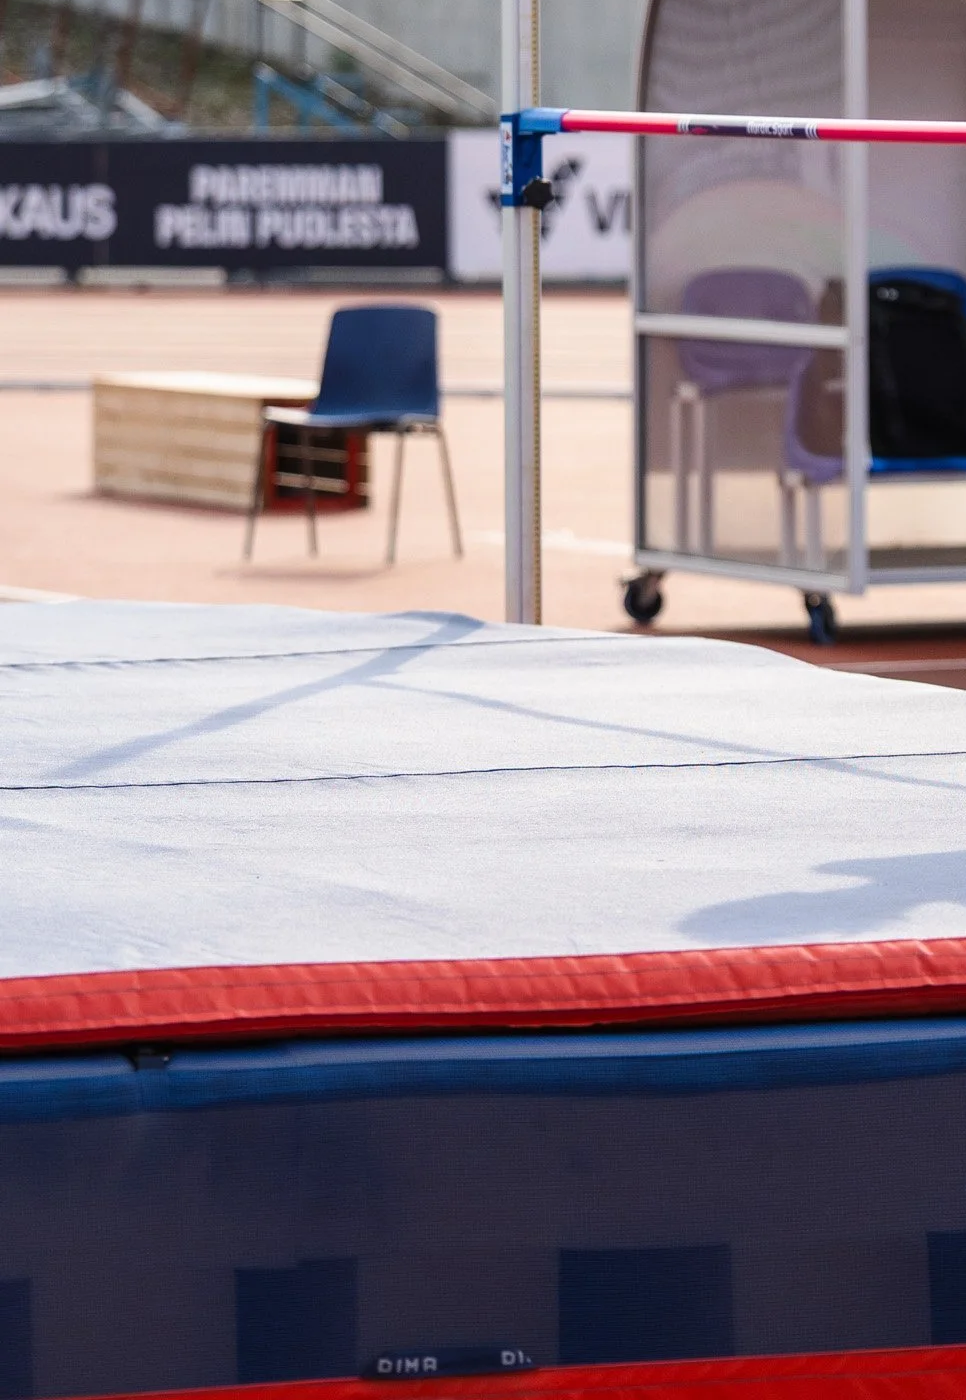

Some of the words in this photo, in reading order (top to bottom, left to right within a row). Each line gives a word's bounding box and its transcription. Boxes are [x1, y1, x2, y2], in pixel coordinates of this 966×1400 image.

[154, 204, 250, 249] PELIN
[255, 204, 419, 249] PUOLESTA
[377, 1357, 438, 1373] DIMA
